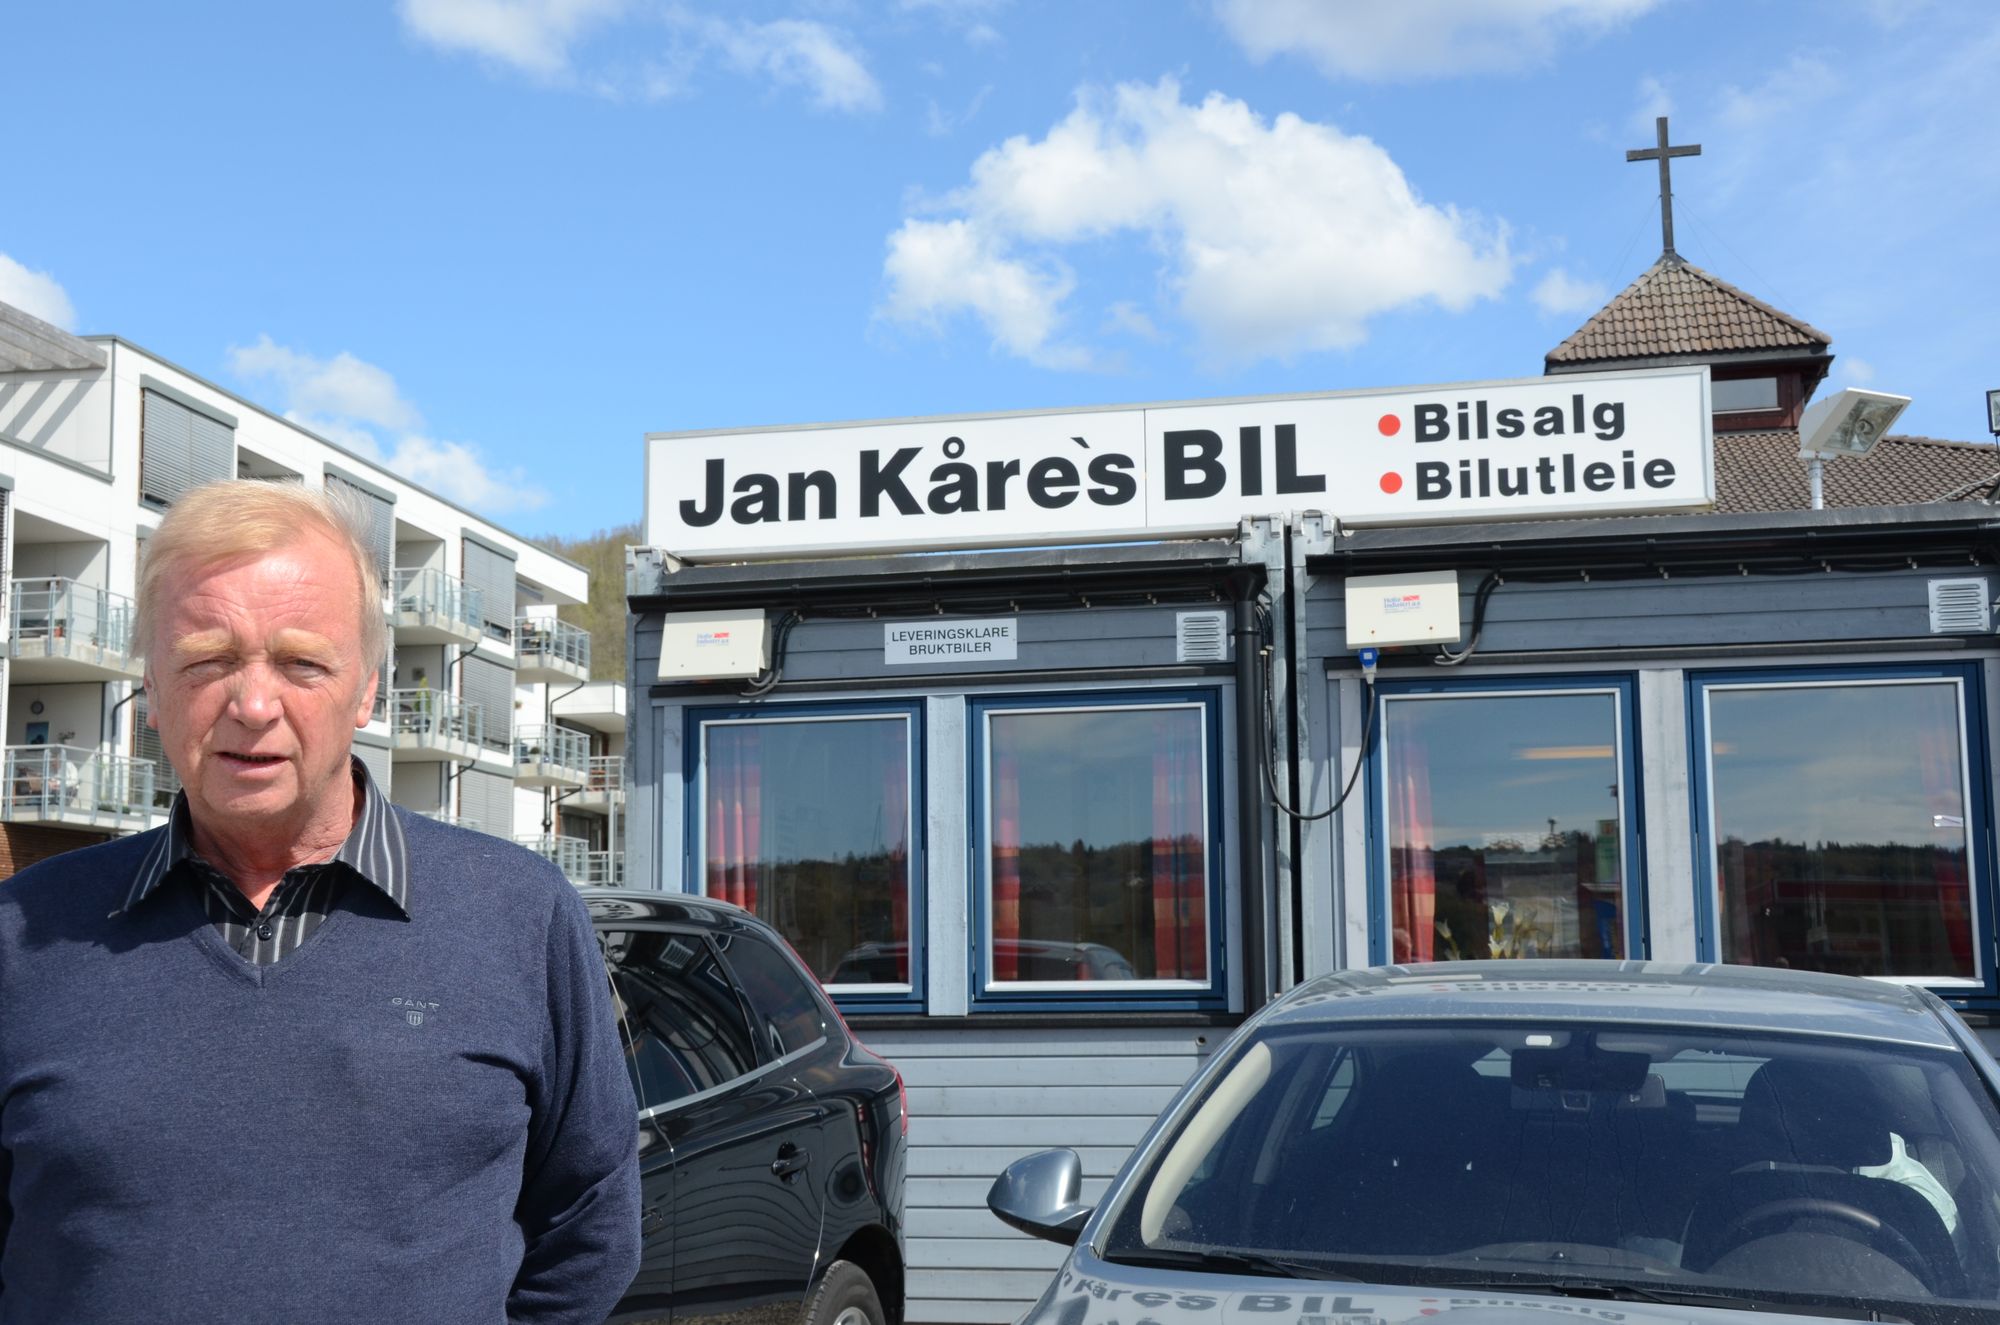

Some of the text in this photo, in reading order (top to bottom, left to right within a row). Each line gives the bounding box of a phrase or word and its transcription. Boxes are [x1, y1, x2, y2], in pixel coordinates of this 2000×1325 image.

[1413, 393, 1626, 443] Bilsalg
[679, 458, 837, 528] Jan
[1163, 423, 1327, 501] BIL
[1415, 450, 1677, 501] Bilutleie
[891, 626, 1009, 642] LEVERINGSKLARE
[909, 641, 992, 656] BRUKTBILER
[392, 997, 440, 1012] GANT
[1237, 1294, 1375, 1314] BIL
